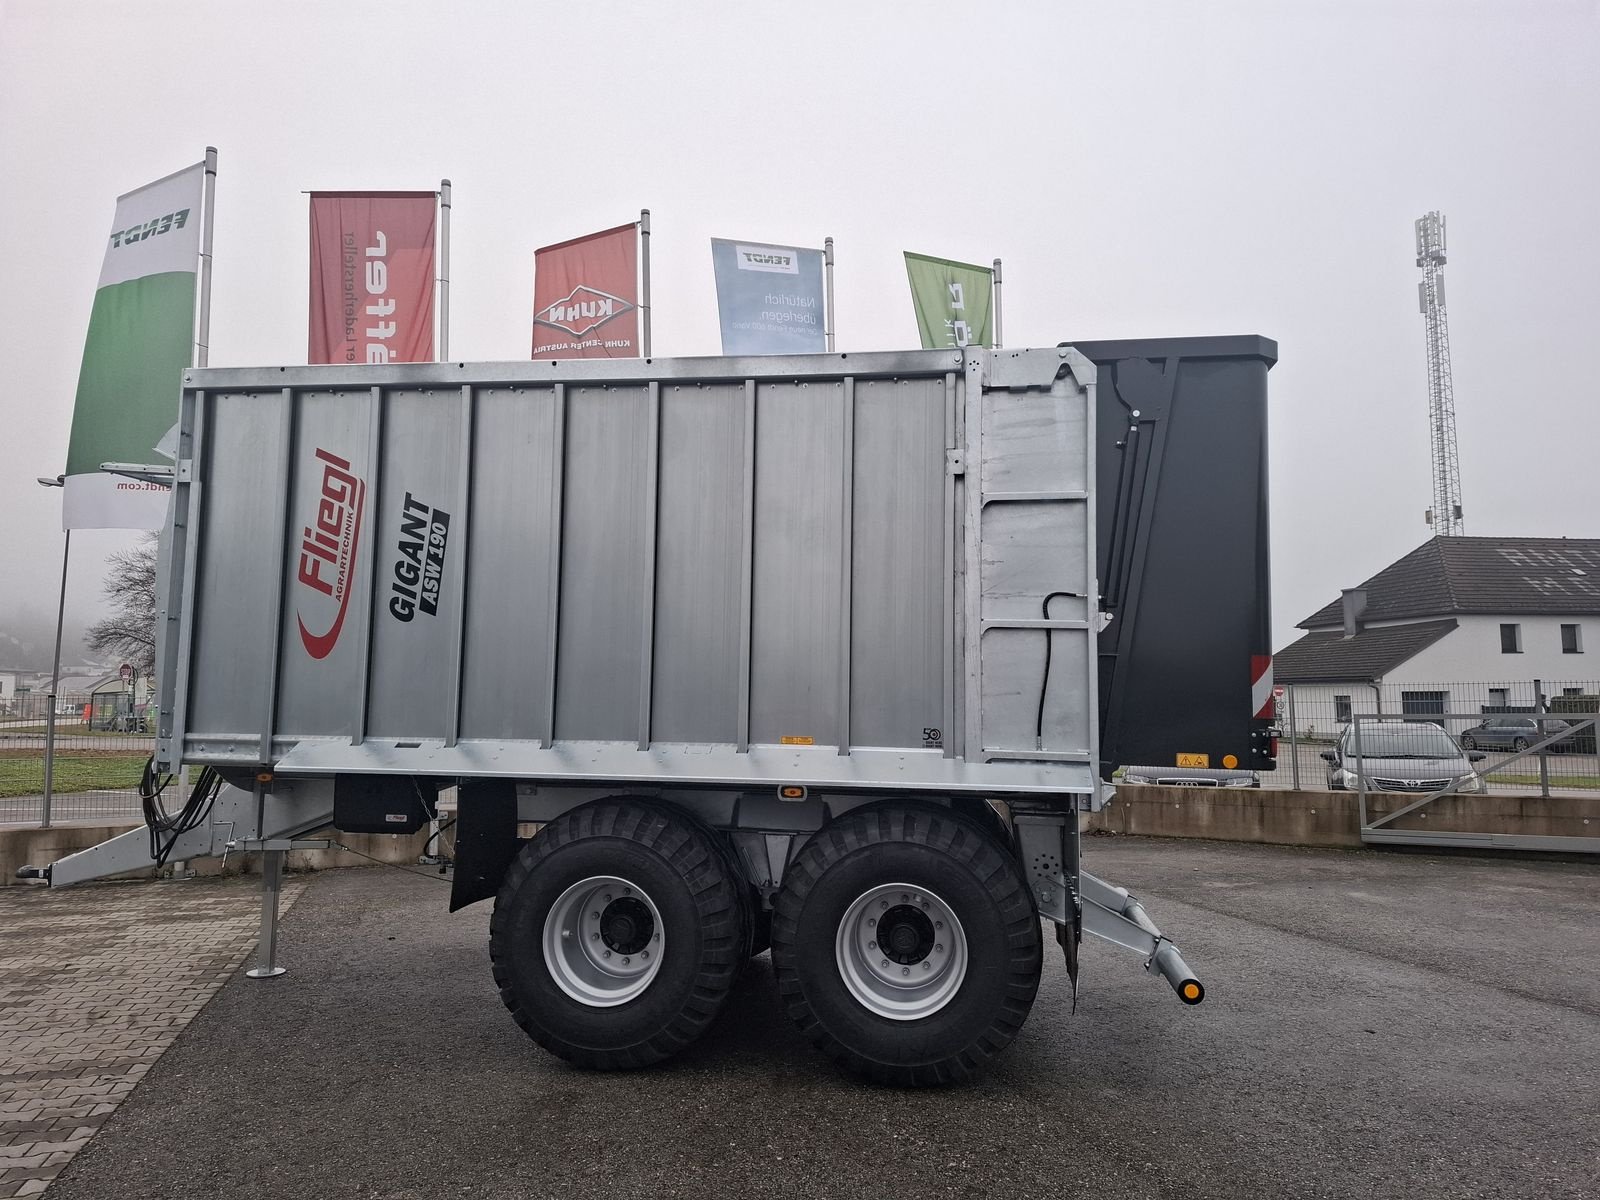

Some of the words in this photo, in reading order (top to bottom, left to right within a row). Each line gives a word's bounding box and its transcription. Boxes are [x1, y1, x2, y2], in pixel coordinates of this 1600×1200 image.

[298, 447, 358, 597] Fliegl
[335, 510, 354, 602] AGRARTECHNIK
[389, 491, 430, 623] GIGANT
[428, 522, 447, 559] 190
[421, 559, 442, 606] ASW
